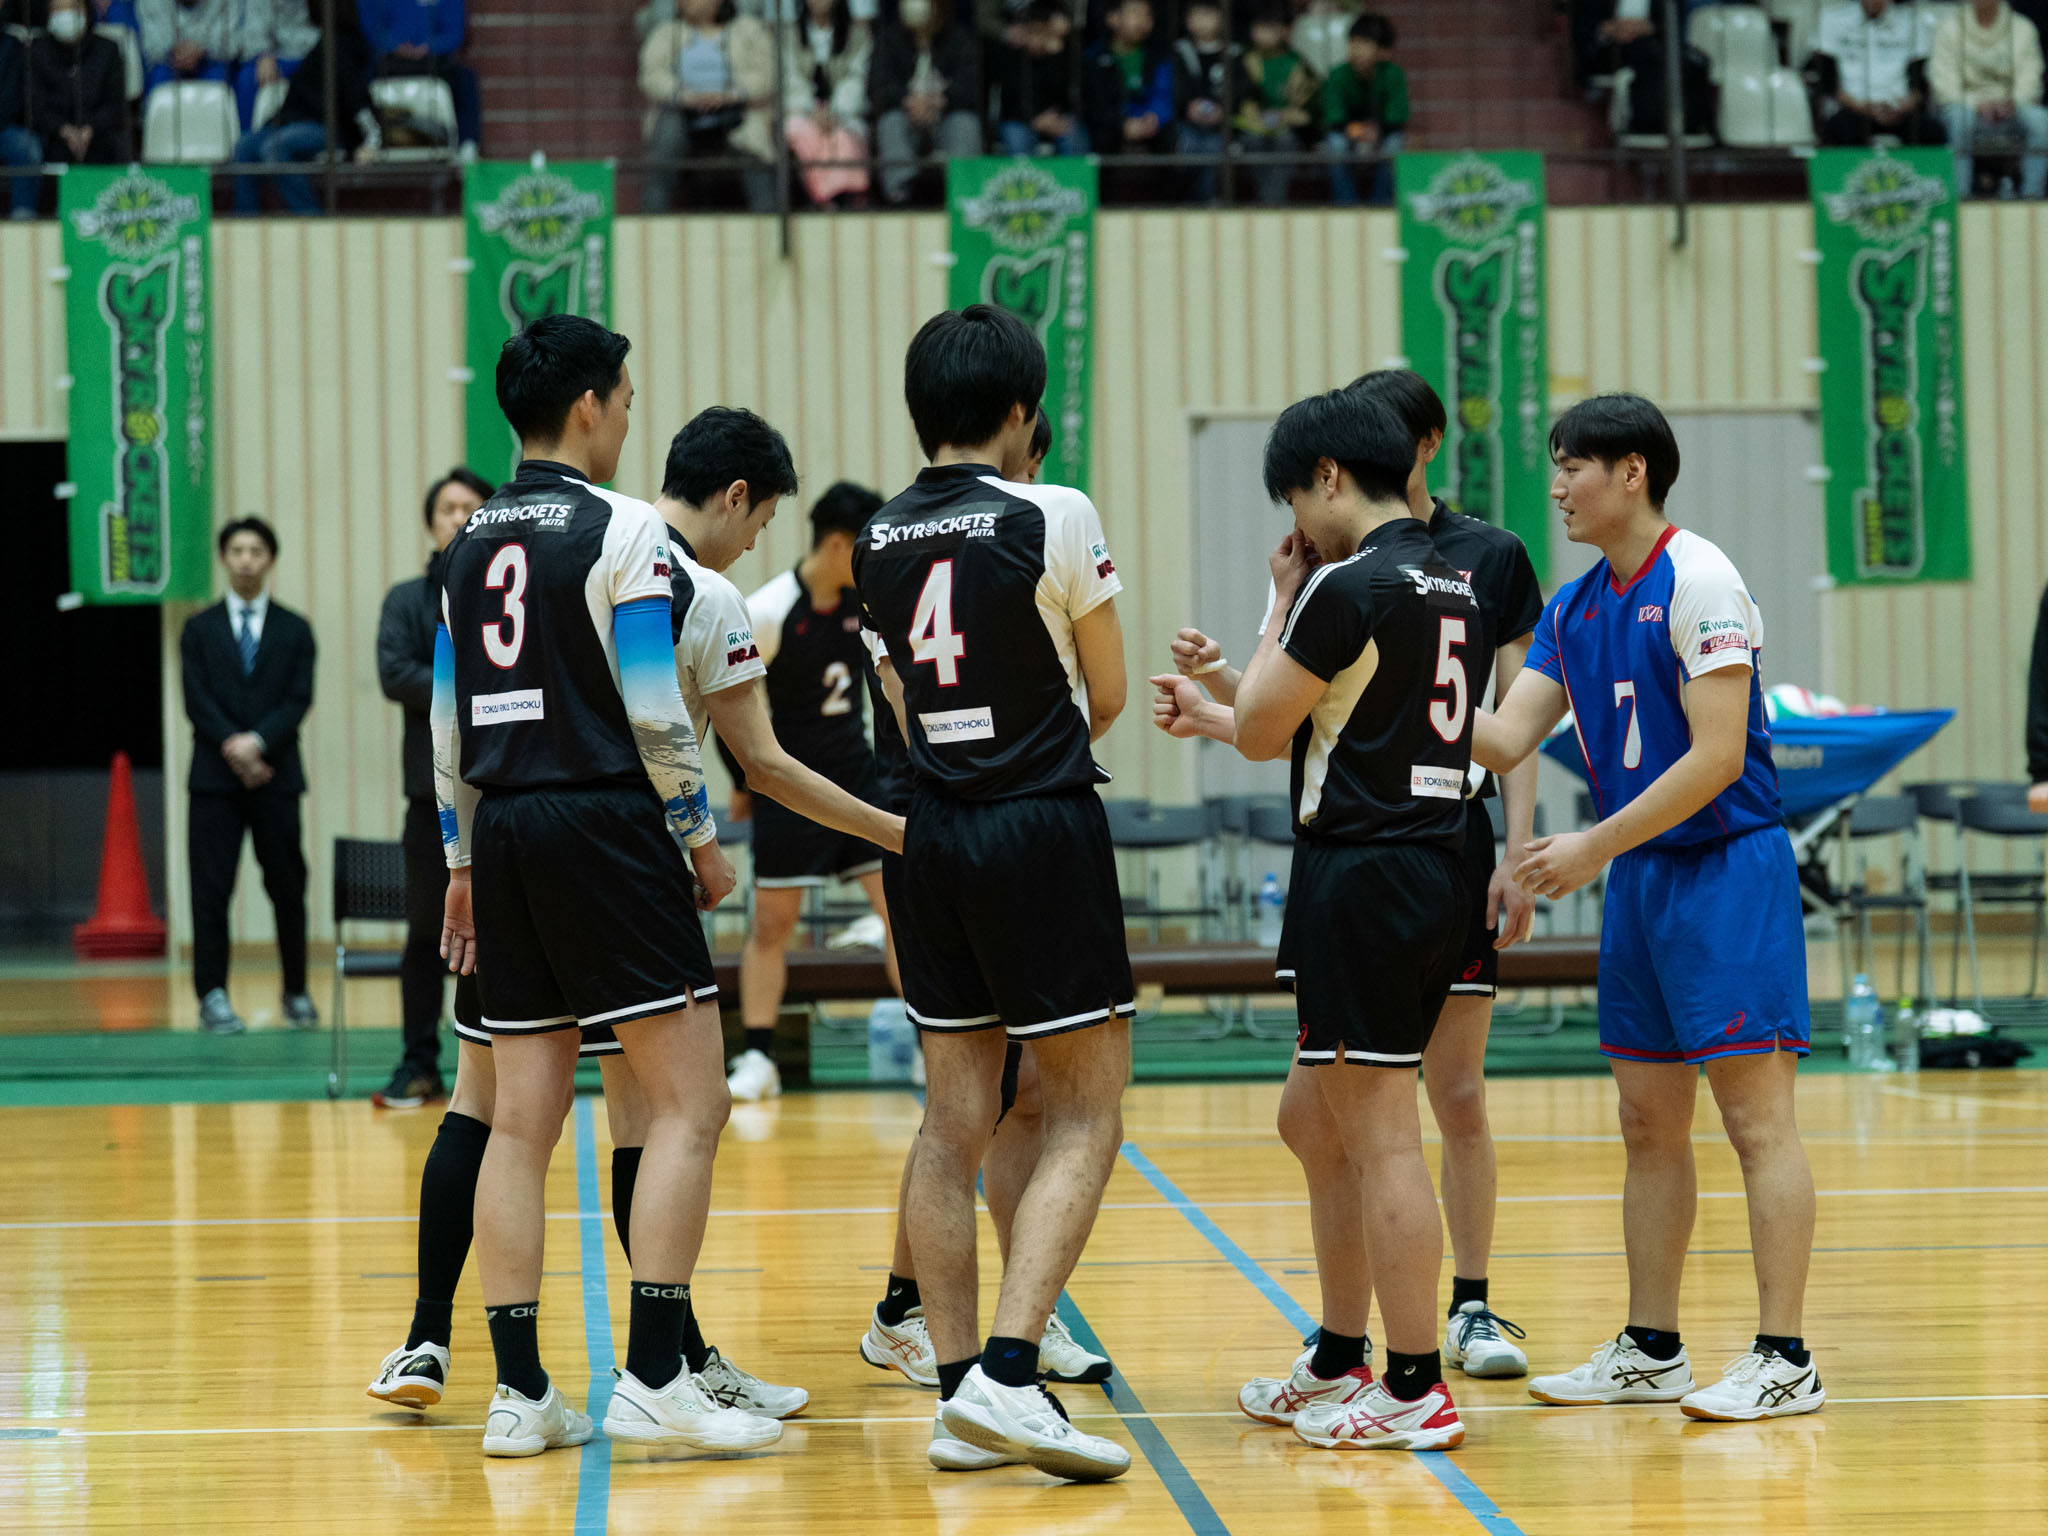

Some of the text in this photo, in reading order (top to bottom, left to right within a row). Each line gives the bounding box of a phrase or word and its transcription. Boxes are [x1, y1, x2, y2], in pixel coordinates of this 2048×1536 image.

[465, 503, 572, 534] SKYROCKETS
[538, 518, 566, 527] AKITA
[870, 512, 997, 551] SKYROCKETS
[966, 528, 996, 539] AKITA
[481, 542, 528, 670] 3
[908, 558, 966, 688] 4
[821, 661, 851, 716] 2
[1429, 615, 1468, 744] 5
[510, 700, 541, 711] TOHOKU
[953, 718, 990, 730] TOHOKU
[1614, 679, 1642, 770] 7
